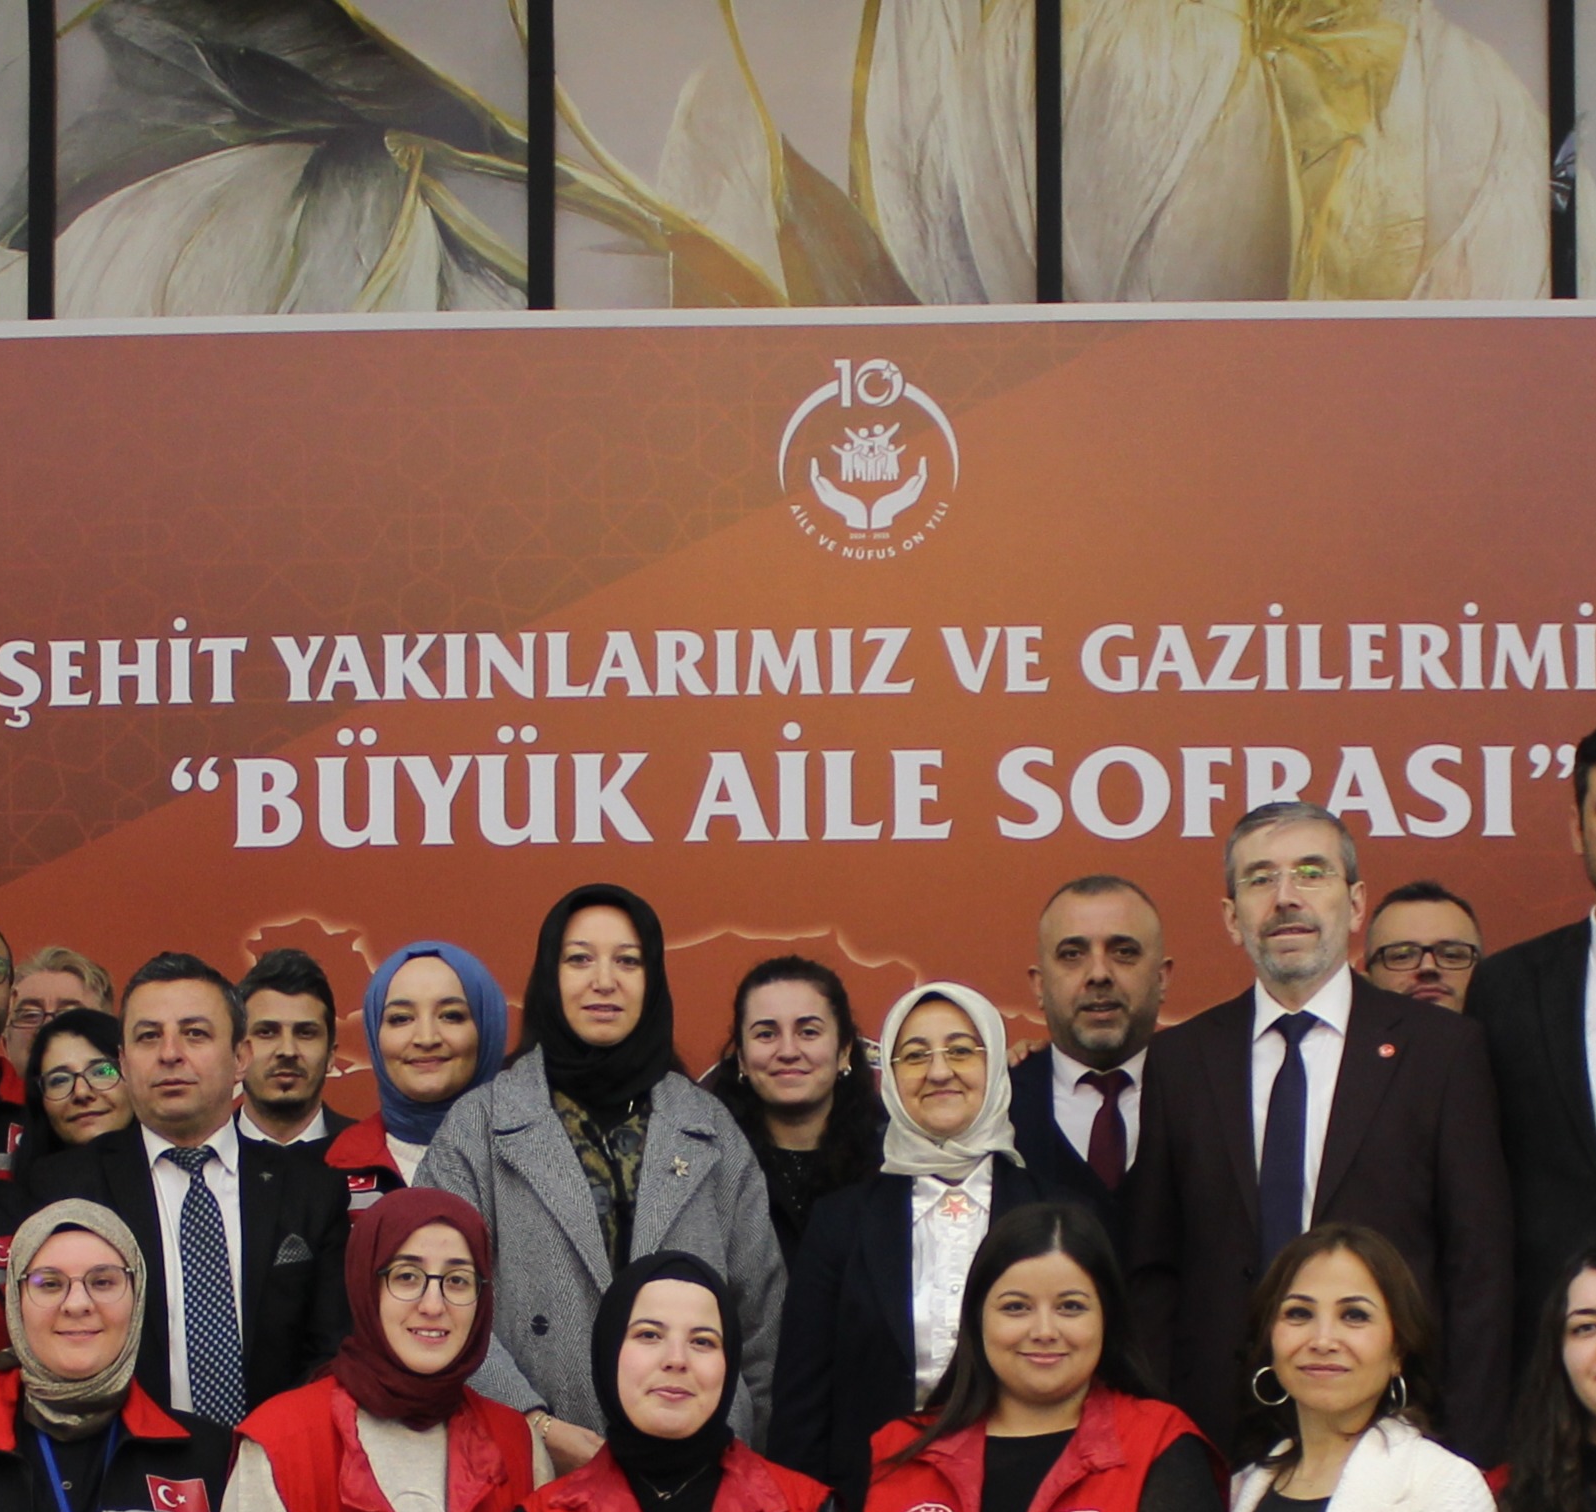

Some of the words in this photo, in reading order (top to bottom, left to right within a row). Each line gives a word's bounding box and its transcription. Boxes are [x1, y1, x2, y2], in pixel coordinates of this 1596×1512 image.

[790, 503, 816, 535] AİLE
[818, 534, 837, 552] VE
[842, 545, 896, 560] NÜFUS
[902, 531, 925, 551] ON
[925, 501, 949, 530] YILI
[272, 628, 913, 701] YAKINLARIMIZ
[941, 627, 1048, 693] VE
[685, 722, 951, 841] AİLE
